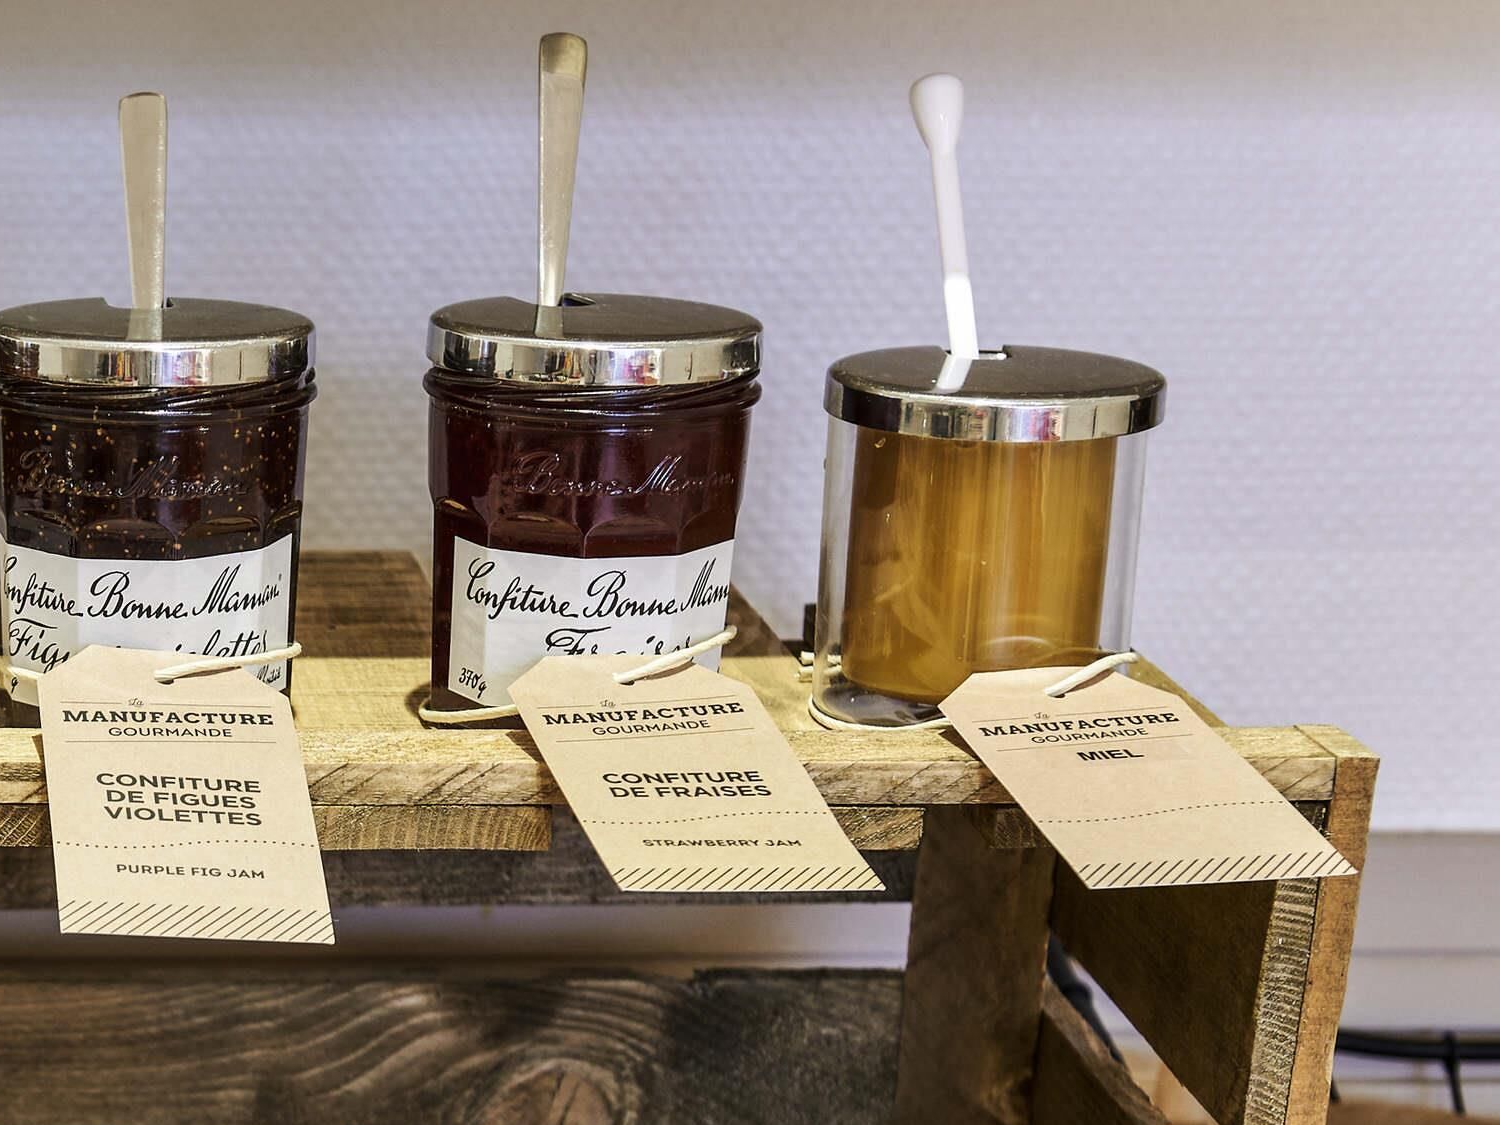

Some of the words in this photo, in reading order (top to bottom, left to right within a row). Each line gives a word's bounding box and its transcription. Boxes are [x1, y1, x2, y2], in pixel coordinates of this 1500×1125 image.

[87, 570, 188, 619] Bonne
[192, 563, 281, 616] Maman
[466, 557, 578, 620] Confiture
[582, 569, 678, 618] Bonne
[680, 556, 730, 612] Mam
[62, 710, 274, 726] MANUFACTURE
[541, 703, 744, 725] MANUFACTURE
[108, 727, 233, 738] GOURMANDE
[592, 719, 711, 736] GOURMANDE
[979, 713, 1179, 736] MANUFACTURE
[1031, 727, 1149, 745] GOURMANDE
[1076, 749, 1145, 762] MIEL
[96, 772, 262, 793] CONFITURE
[602, 771, 764, 784] CONFITURE
[106, 789, 145, 804] DE
[153, 792, 257, 810] FIGUES
[608, 786, 650, 798] DE
[658, 785, 773, 798] FRAISES
[104, 806, 263, 826] VIOLETTES
[642, 839, 760, 847] STRAWBERRY
[764, 839, 803, 847] JAM
[116, 864, 186, 876] PURPLE
[191, 867, 222, 878] FIG
[227, 868, 265, 880] JAM
